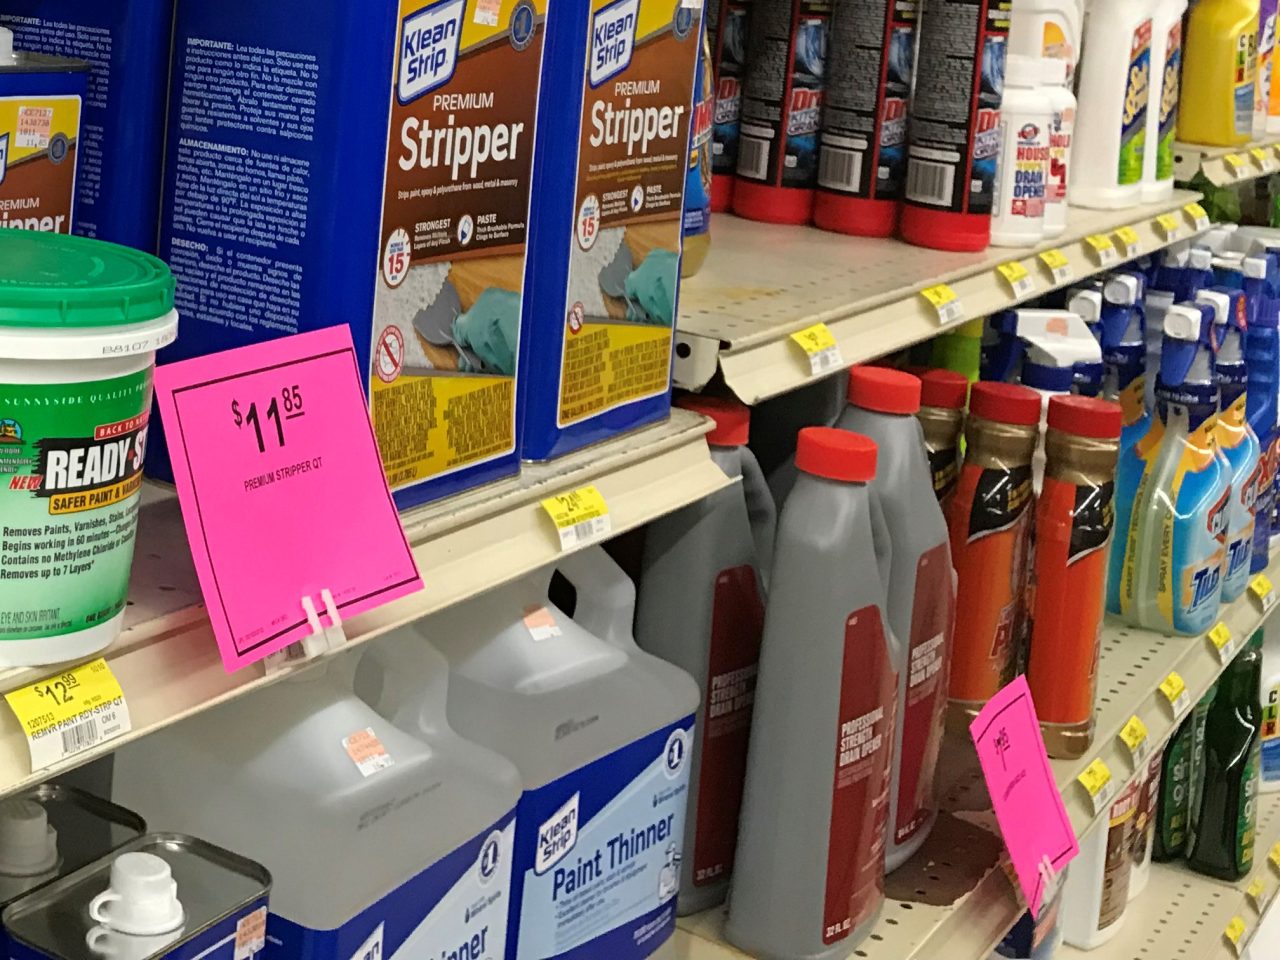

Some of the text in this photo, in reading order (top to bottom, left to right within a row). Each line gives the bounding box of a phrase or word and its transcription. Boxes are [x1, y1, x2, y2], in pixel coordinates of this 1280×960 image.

[187, 38, 234, 50] IMPORTANTE:
[404, 18, 456, 58] Klean
[594, 13, 633, 46] Klean
[407, 48, 447, 85] Strip
[596, 39, 626, 70] Strip
[433, 92, 494, 111] PREMIUM
[615, 80, 660, 96] PREMIUM
[590, 98, 684, 155] Stripper
[179, 139, 249, 156] ALMACENAMIENTO:
[399, 114, 523, 180] Stripper
[582, 217, 594, 236] 15
[172, 237, 208, 251] DESECHO:
[388, 253, 404, 276] 15
[244, 457, 322, 491] PREMIUM STRIPPER QT
[53, 486, 120, 510] SAFER PAINT &
[27, 712, 54, 729] 1207513
[31, 696, 122, 740] REMVR PAINT RDY-STRP QT
[842, 706, 883, 737] PROFESSIONAL
[841, 727, 873, 752] STRENGTH
[540, 809, 575, 848] Klean
[543, 829, 572, 863] Strip
[553, 849, 602, 902] Paint
[607, 813, 674, 869] Thinner
